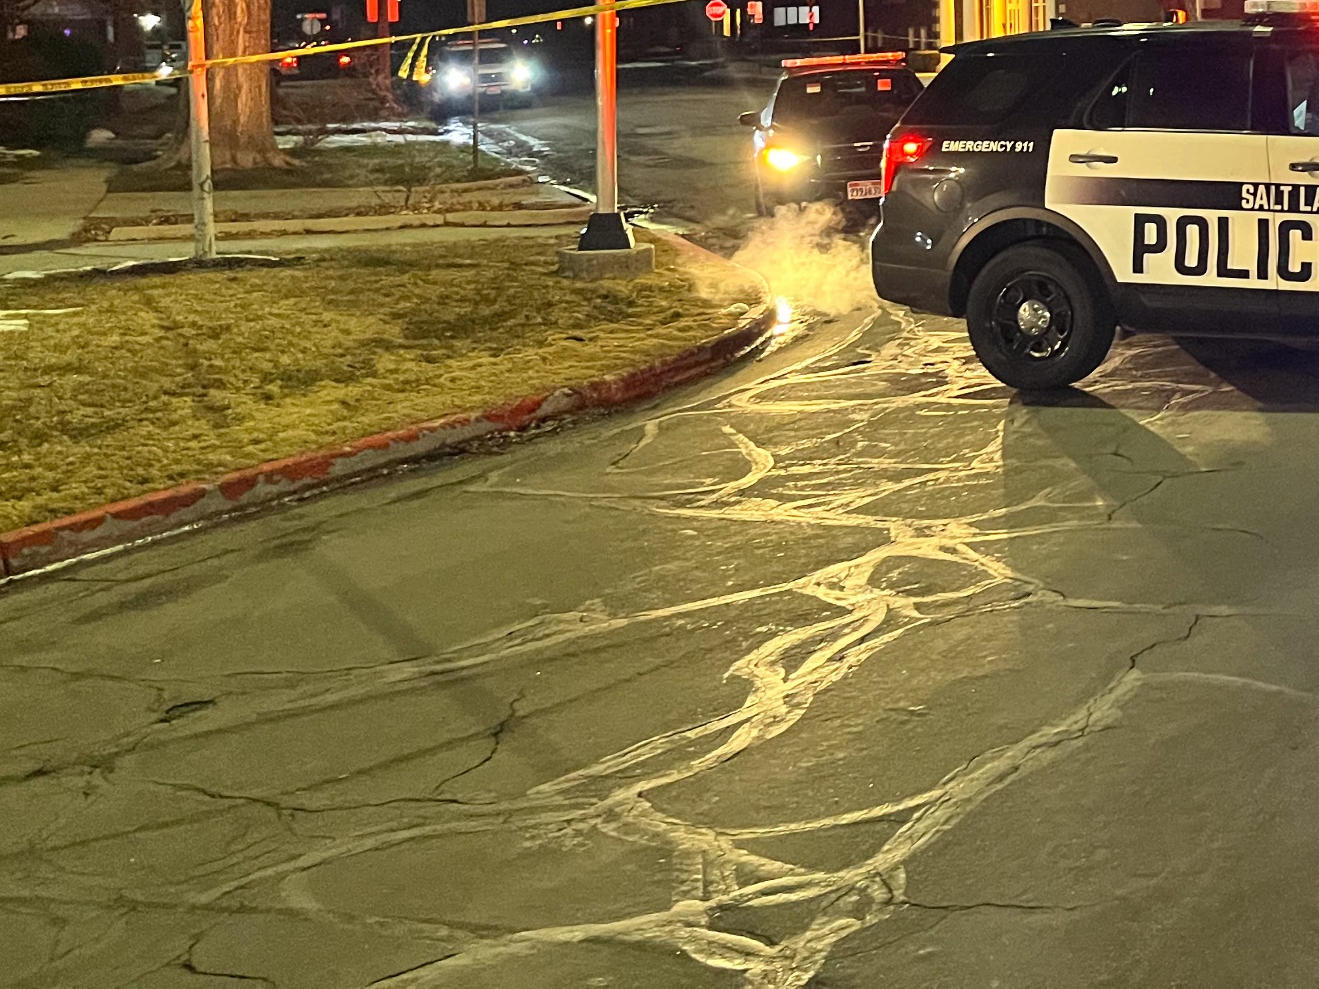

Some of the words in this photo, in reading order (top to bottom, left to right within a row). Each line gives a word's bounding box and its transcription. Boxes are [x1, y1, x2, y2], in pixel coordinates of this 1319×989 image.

[941, 139, 1014, 153] EMERGENCY
[1015, 141, 1034, 153] 911
[1241, 183, 1293, 211] SALT
